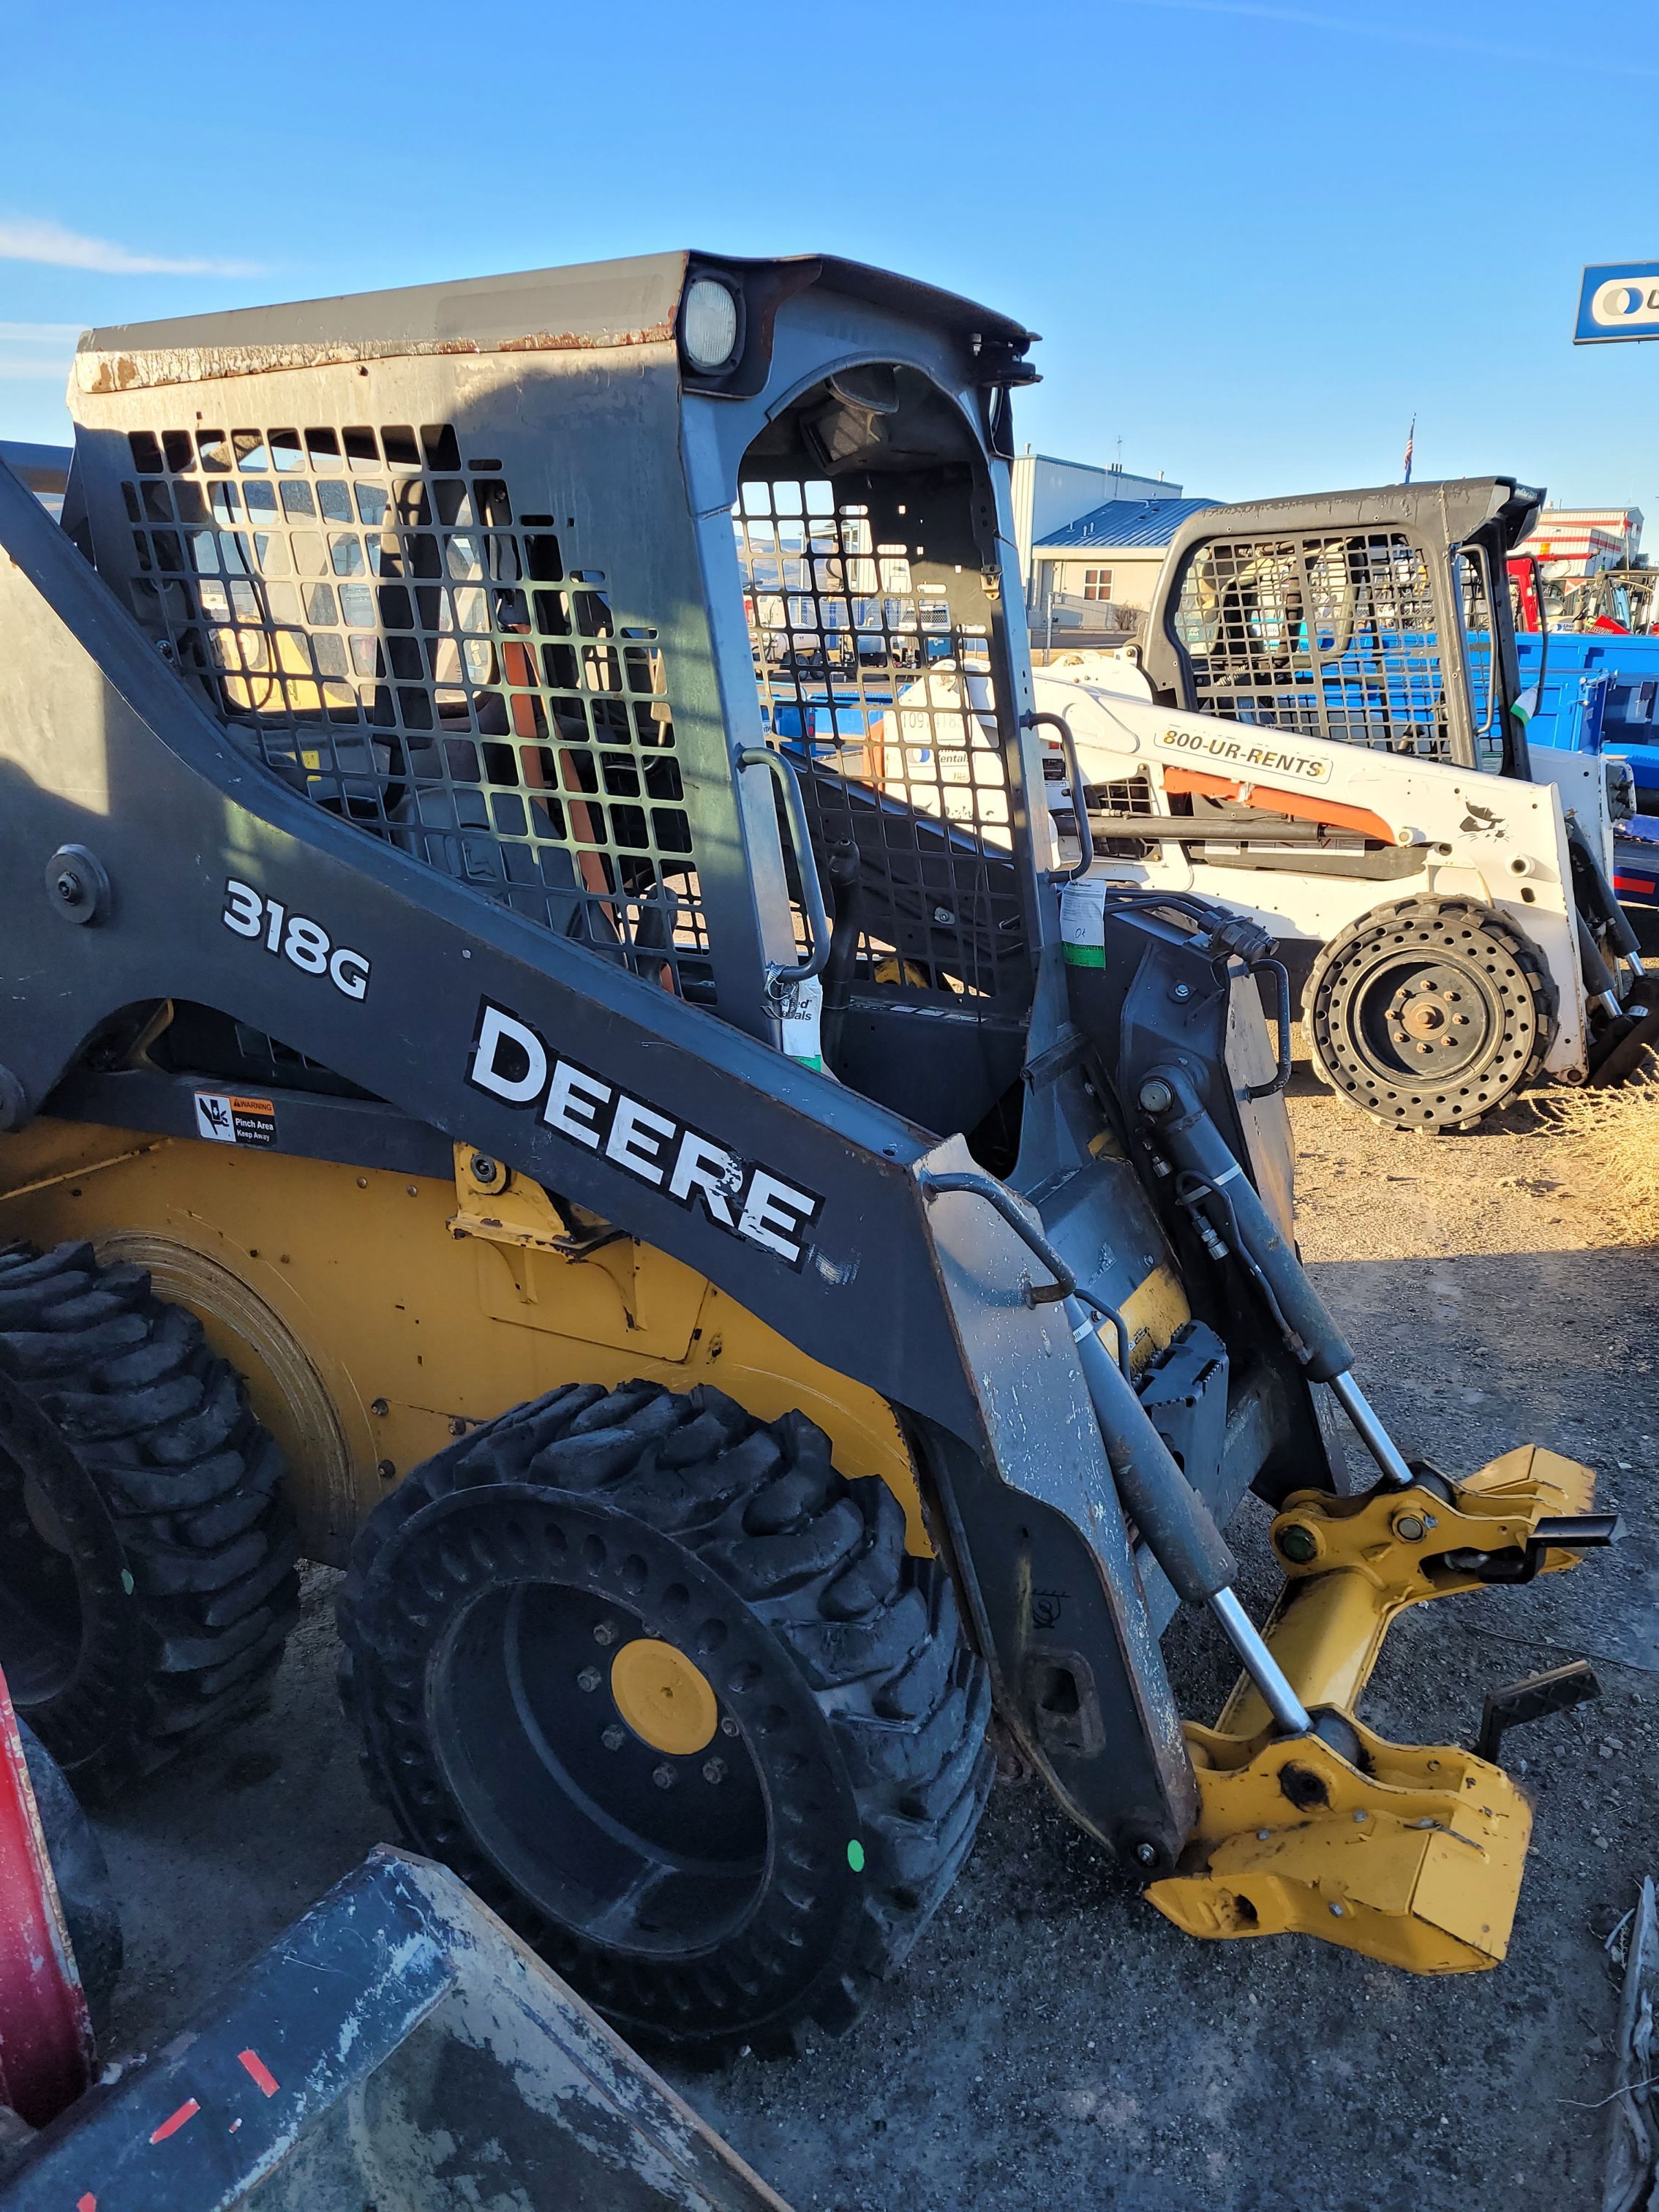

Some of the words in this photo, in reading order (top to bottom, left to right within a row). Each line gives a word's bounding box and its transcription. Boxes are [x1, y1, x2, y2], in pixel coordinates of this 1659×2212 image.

[937, 753, 968, 764] ental
[1164, 730, 1323, 777] 800-UR-RENTS
[223, 880, 369, 999] 318G
[240, 1100, 272, 1110] WARNING
[235, 1118, 255, 1128] Pinch
[257, 1121, 274, 1130] Area
[236, 1129, 252, 1139] Keep
[253, 1132, 270, 1141] Away
[472, 1006, 815, 1262] DEERE
